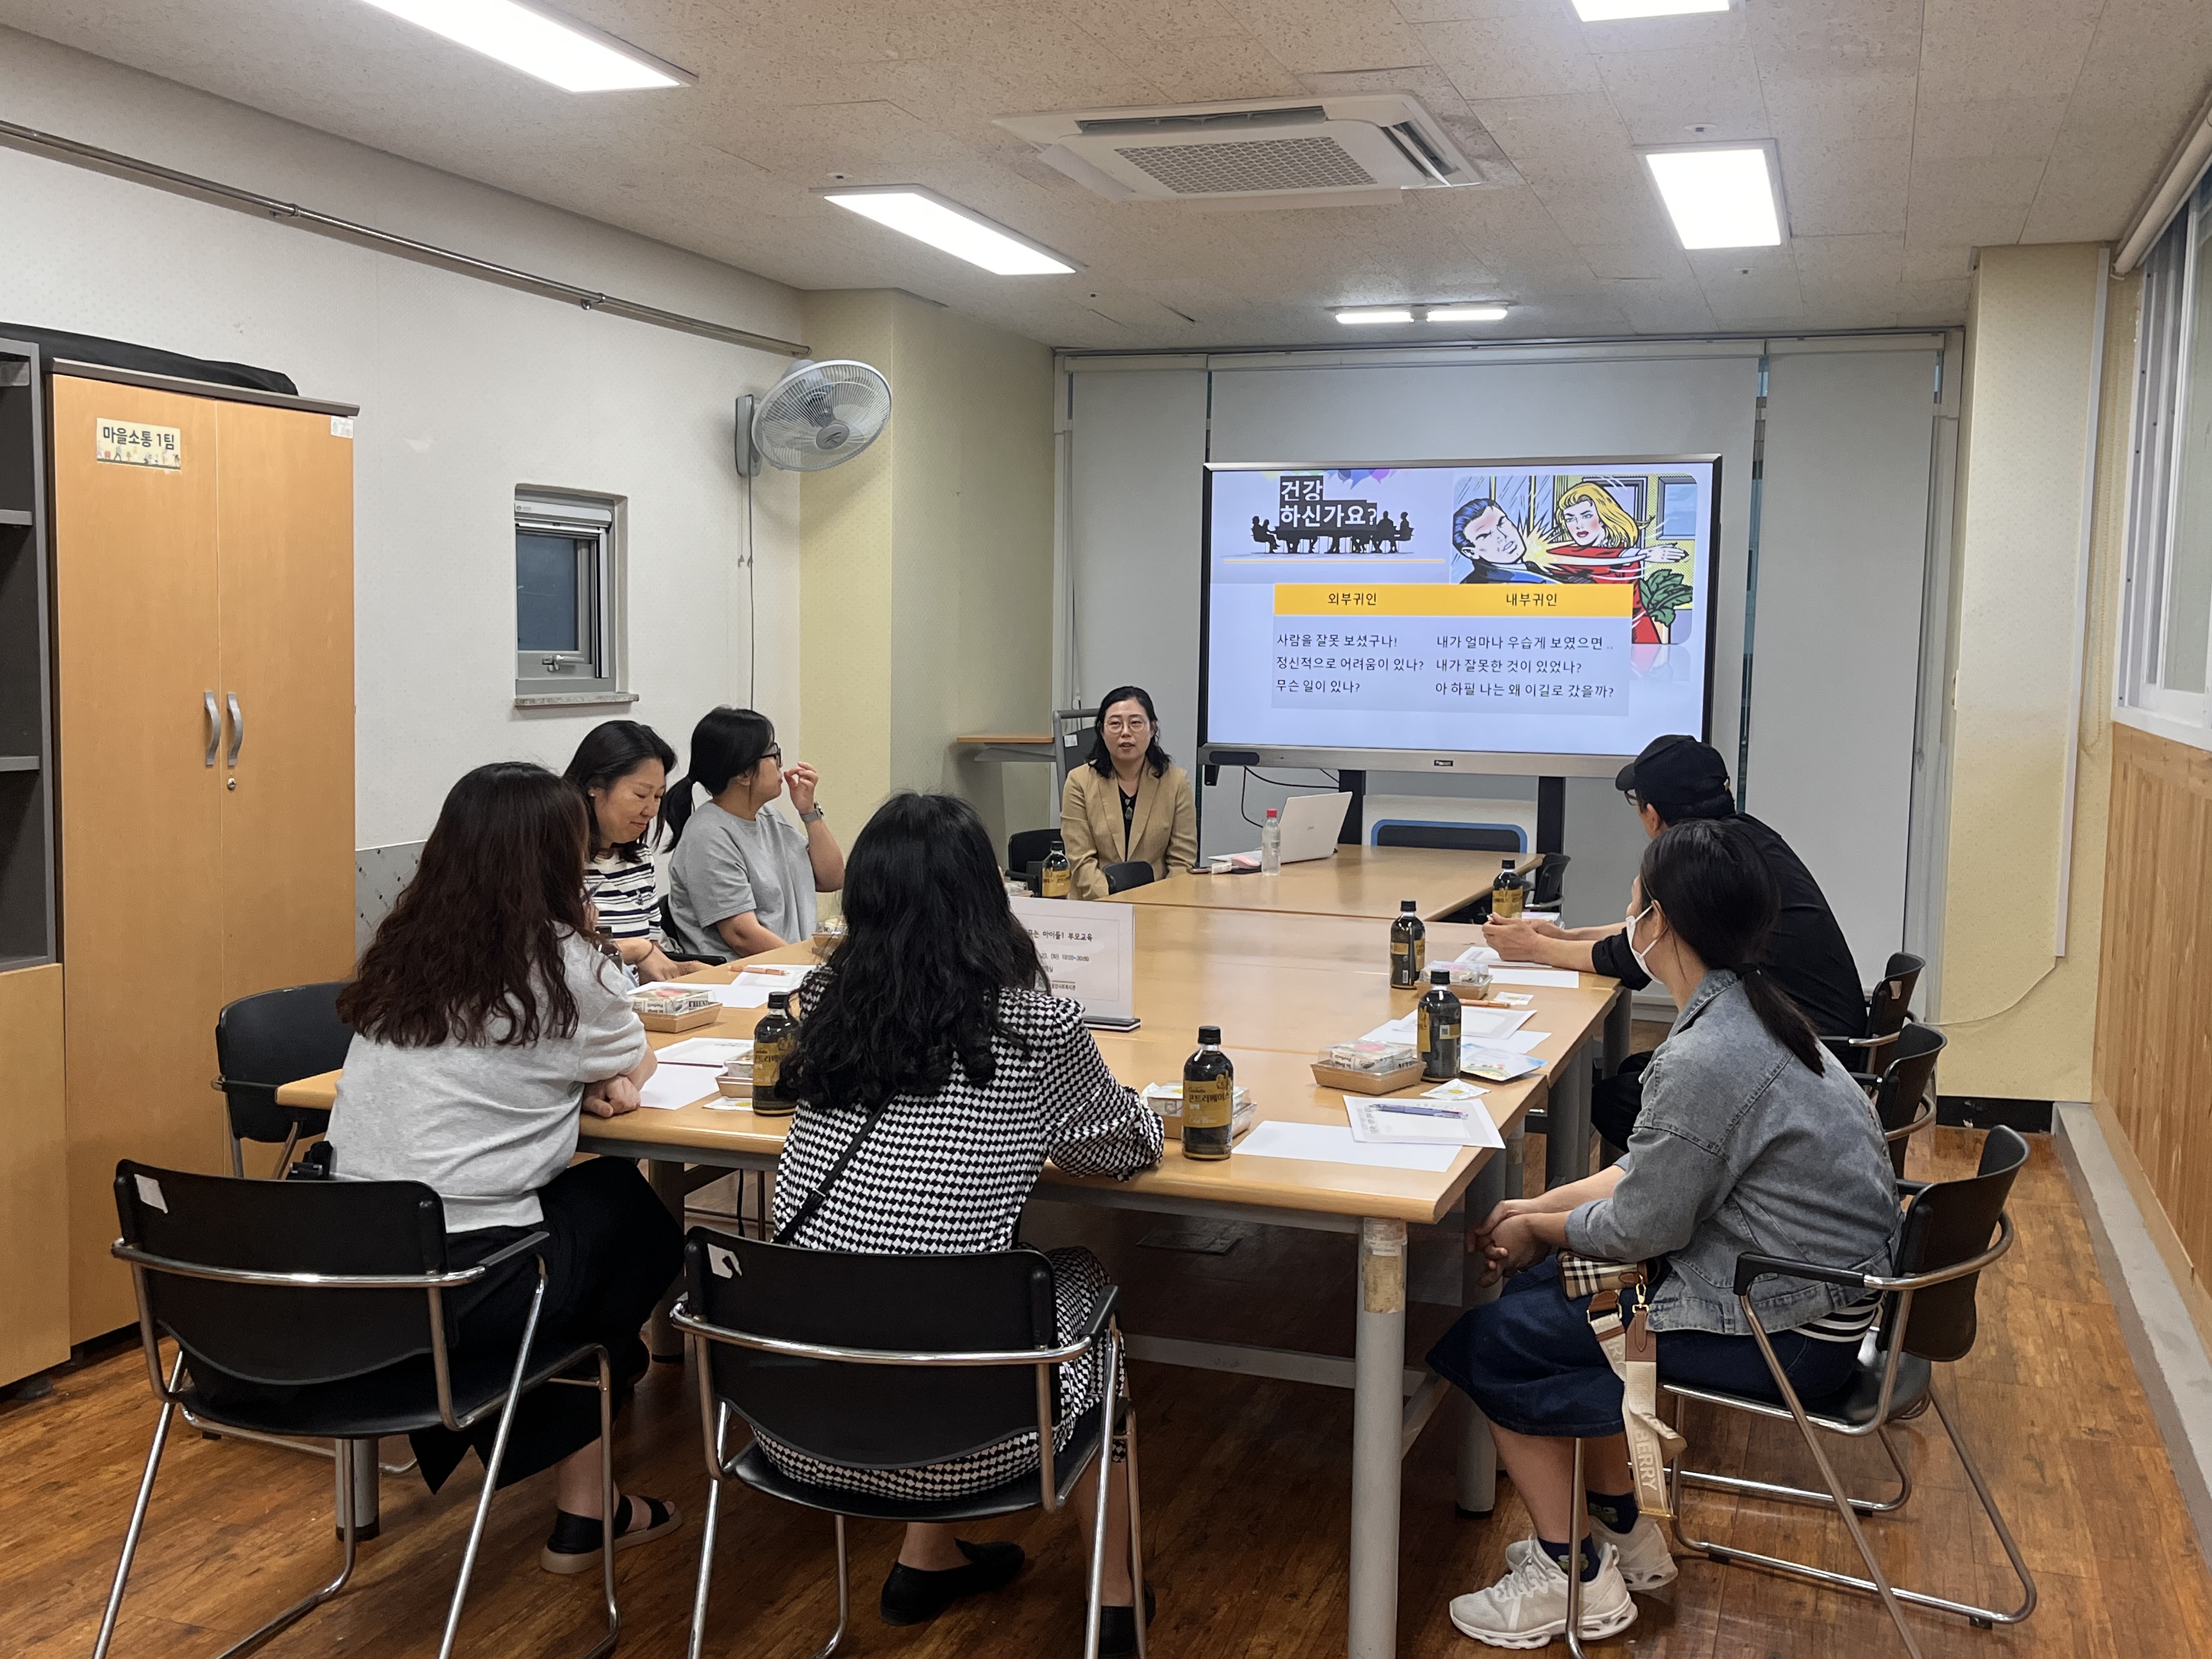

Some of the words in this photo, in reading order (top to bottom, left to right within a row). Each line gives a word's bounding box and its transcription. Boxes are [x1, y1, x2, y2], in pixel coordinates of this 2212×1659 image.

[103, 426, 153, 448] 마을소통
[156, 433, 174, 450] 1팀
[1281, 480, 1323, 501] 건강
[1280, 504, 1378, 529] 하신가요?
[1328, 592, 1377, 606] 외부귀인
[1506, 593, 1558, 607] 내부귀인
[1277, 634, 1313, 647] 사람을
[1316, 634, 1340, 647] 잘못
[1344, 635, 1398, 648] 보셨구나!
[1436, 635, 1462, 649] 내가
[1465, 636, 1504, 650] 얼마나
[1507, 636, 1546, 650] 우습게
[1550, 636, 1603, 650] 보였으면
[1276, 657, 1338, 670] 정신적으로
[1340, 658, 1389, 671] 어려움이
[1393, 658, 1424, 672] 있나?
[1436, 658, 1462, 672] 내가
[1464, 659, 1503, 673] 잘못한
[1507, 659, 1532, 673] 것이
[1536, 660, 1582, 674] 있었나?
[1276, 679, 1300, 692] 무슨
[1303, 680, 1326, 693] 일이
[1330, 680, 1361, 693] 있나?
[1435, 682, 1447, 696] 아
[1451, 682, 1475, 696] 하필
[1480, 683, 1505, 697] 나는
[1508, 683, 1521, 697] 왜
[1525, 684, 1564, 698] 이길로
[1567, 684, 1615, 698] 갔을까?
[1068, 932, 1093, 943] 부모교육
